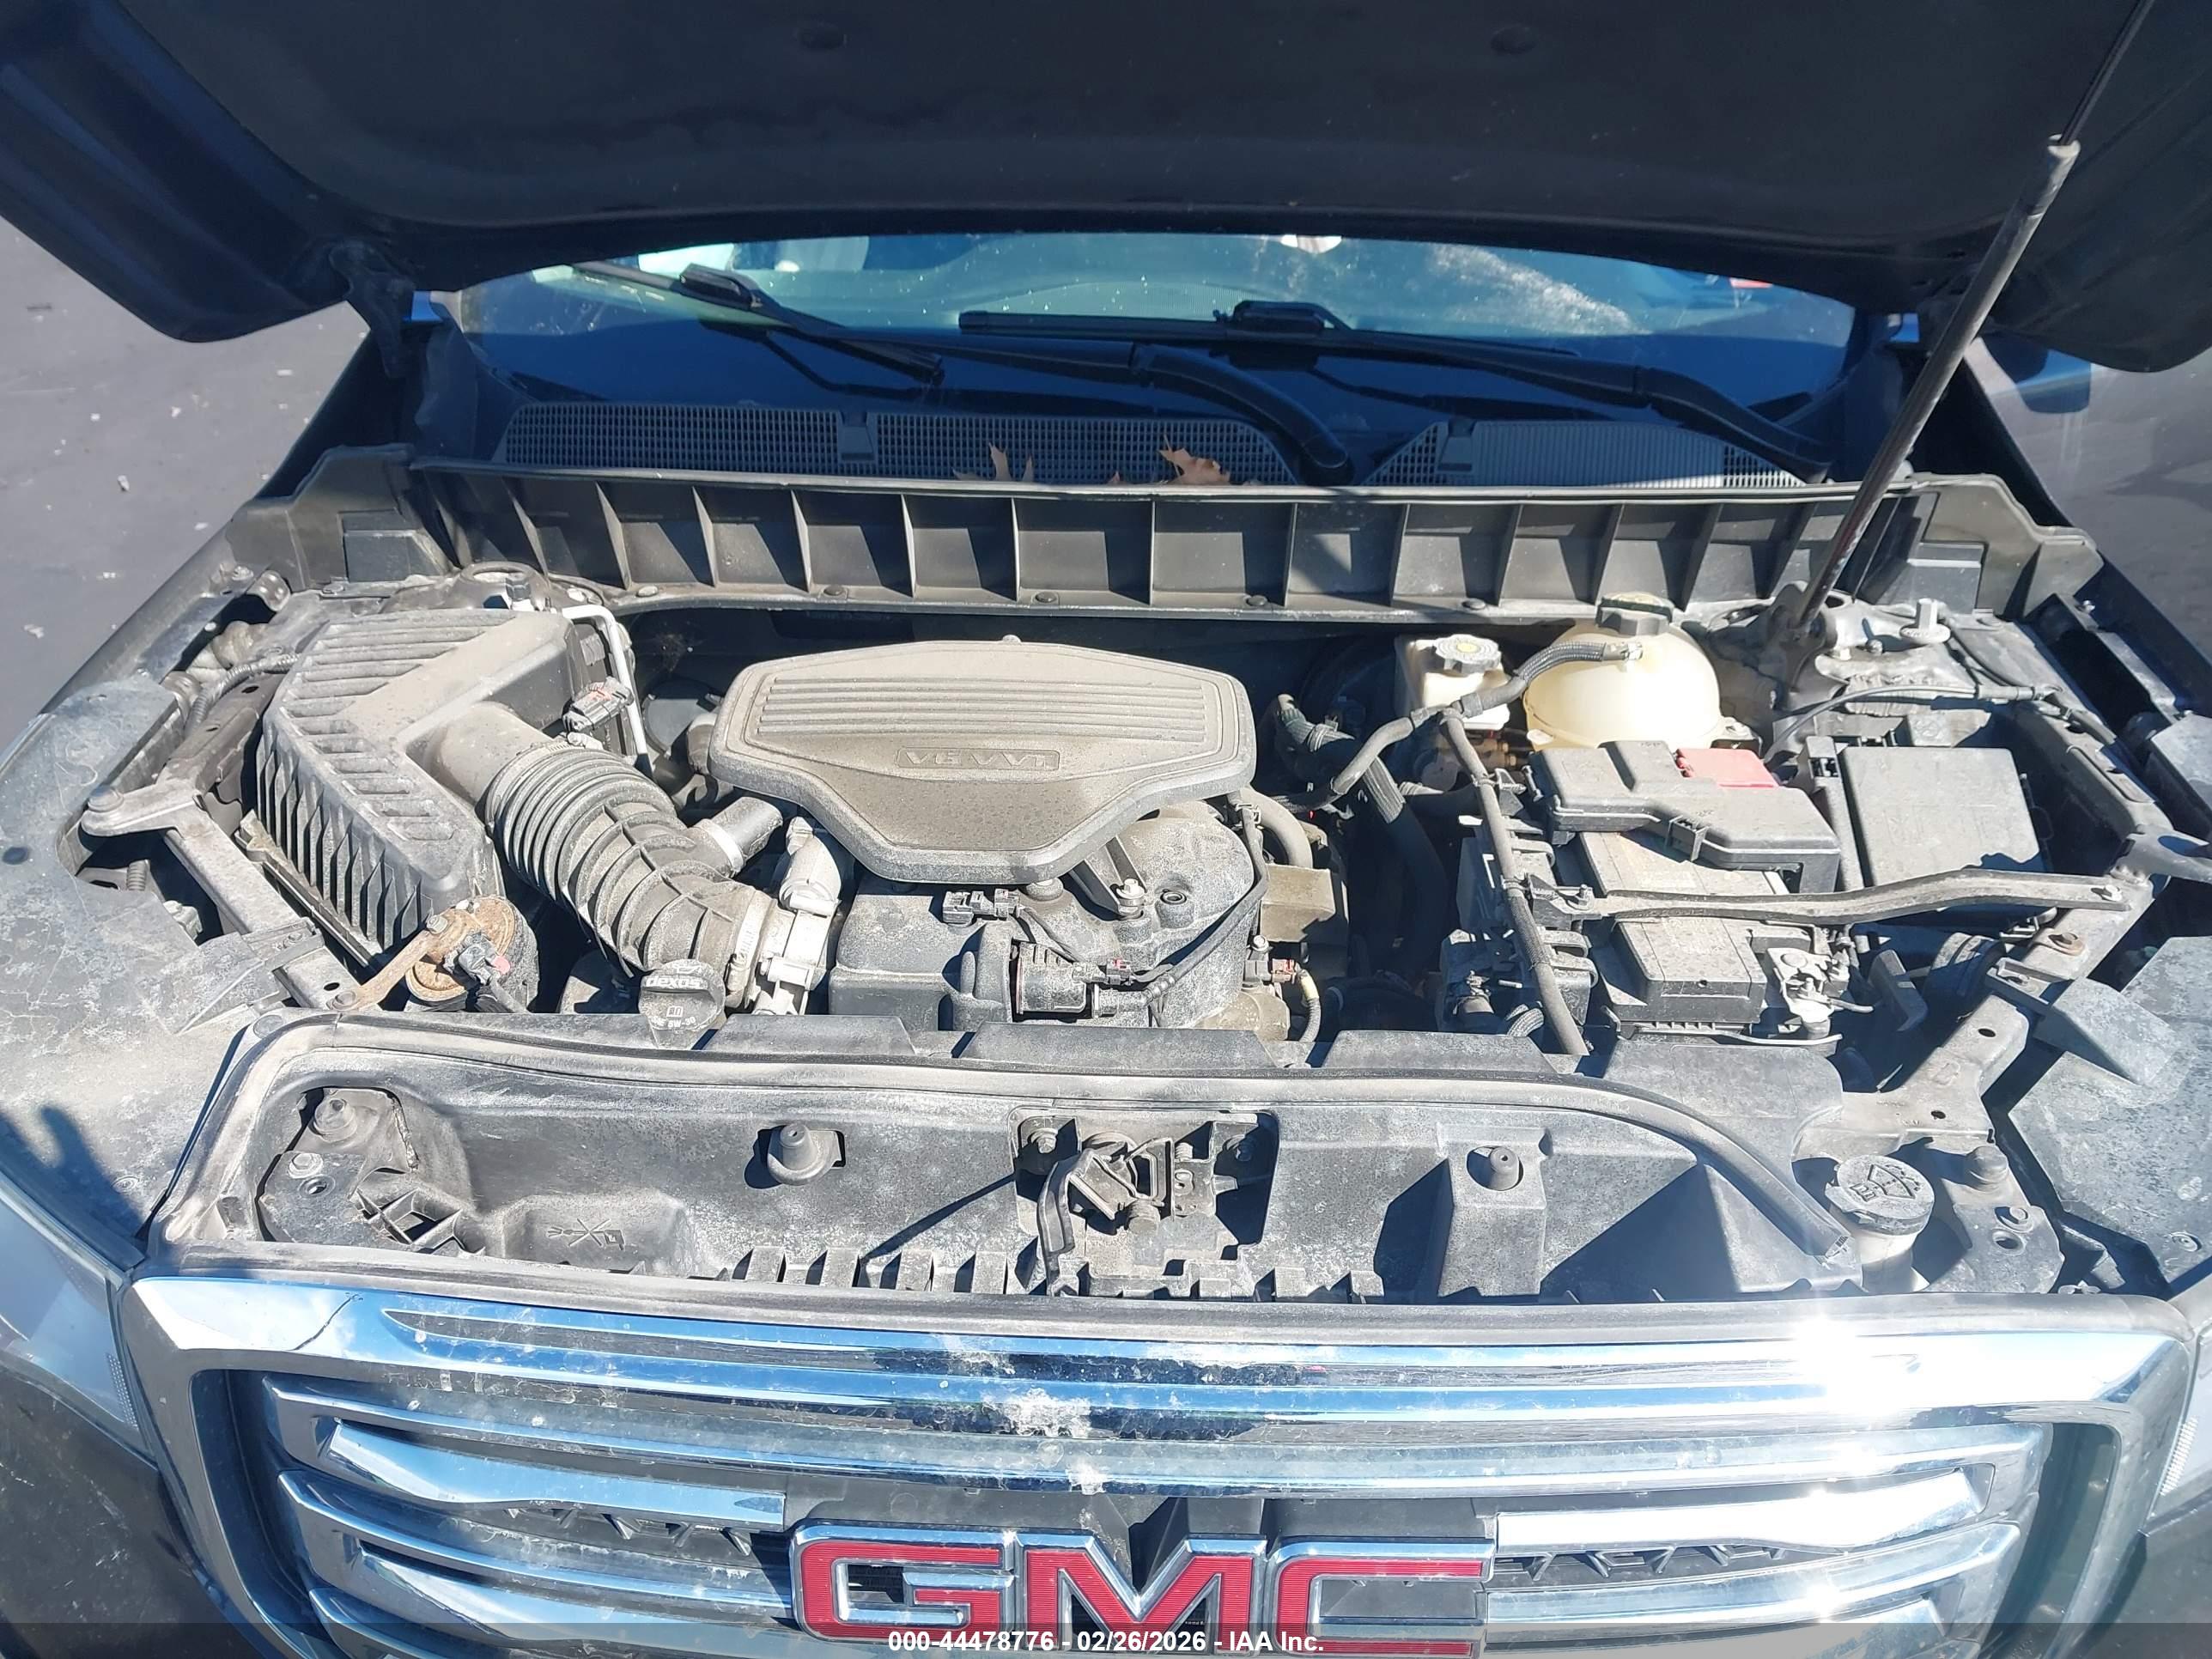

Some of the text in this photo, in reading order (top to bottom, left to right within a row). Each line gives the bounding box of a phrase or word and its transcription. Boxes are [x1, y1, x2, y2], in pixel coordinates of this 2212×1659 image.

[905, 750, 962, 766] V6
[646, 975, 702, 990] dexos
[792, 1525, 1494, 1658] GMC
